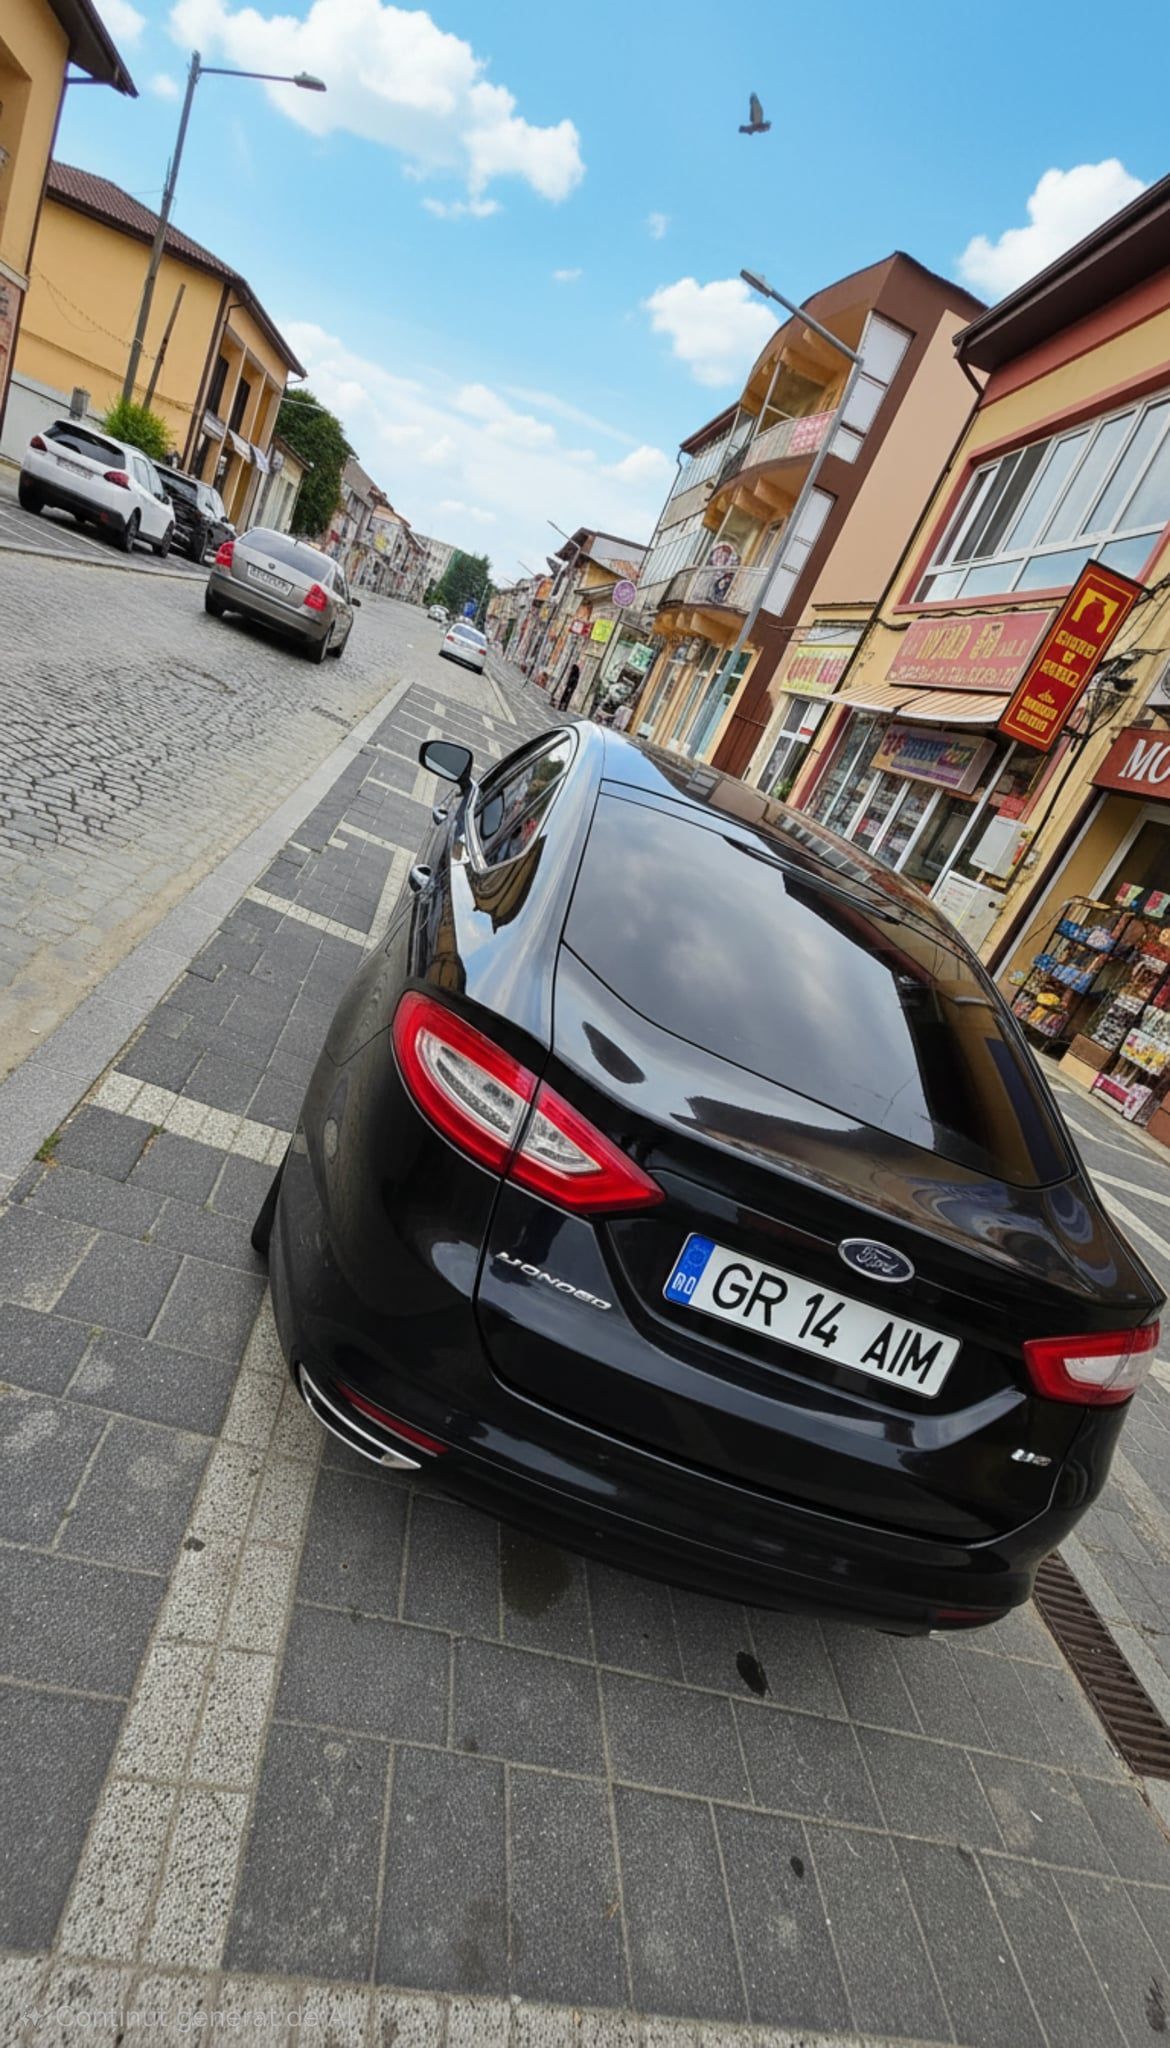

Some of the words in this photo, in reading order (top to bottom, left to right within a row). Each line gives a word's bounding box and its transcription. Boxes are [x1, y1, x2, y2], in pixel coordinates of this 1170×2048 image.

[711, 1262, 788, 1327] GR
[798, 1292, 846, 1349] 14
[859, 1321, 944, 1385] AIM
